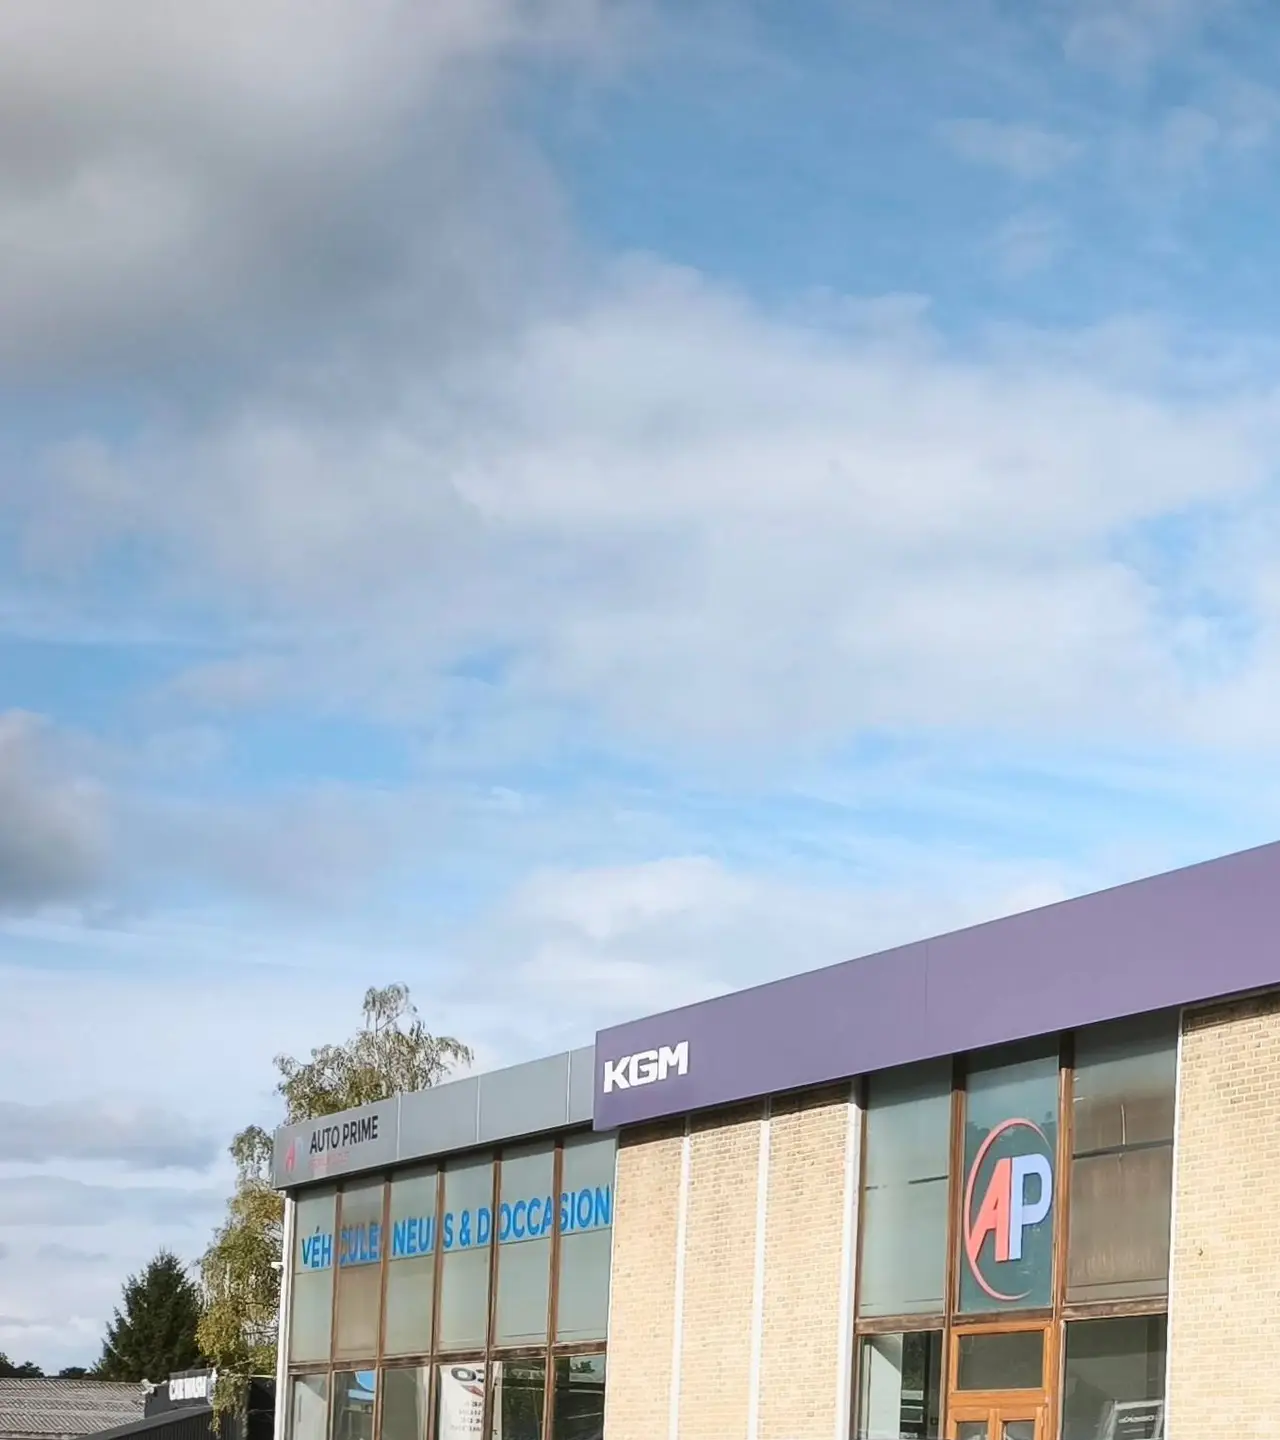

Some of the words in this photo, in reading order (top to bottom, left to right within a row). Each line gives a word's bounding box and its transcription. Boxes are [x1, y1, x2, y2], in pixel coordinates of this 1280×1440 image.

[603, 1040, 689, 1093] KGM
[310, 1125, 340, 1154] AUTO
[342, 1115, 379, 1147] PRIME
[969, 1153, 1053, 1263] AP
[392, 1212, 454, 1257] NEUS
[459, 1210, 471, 1247] &
